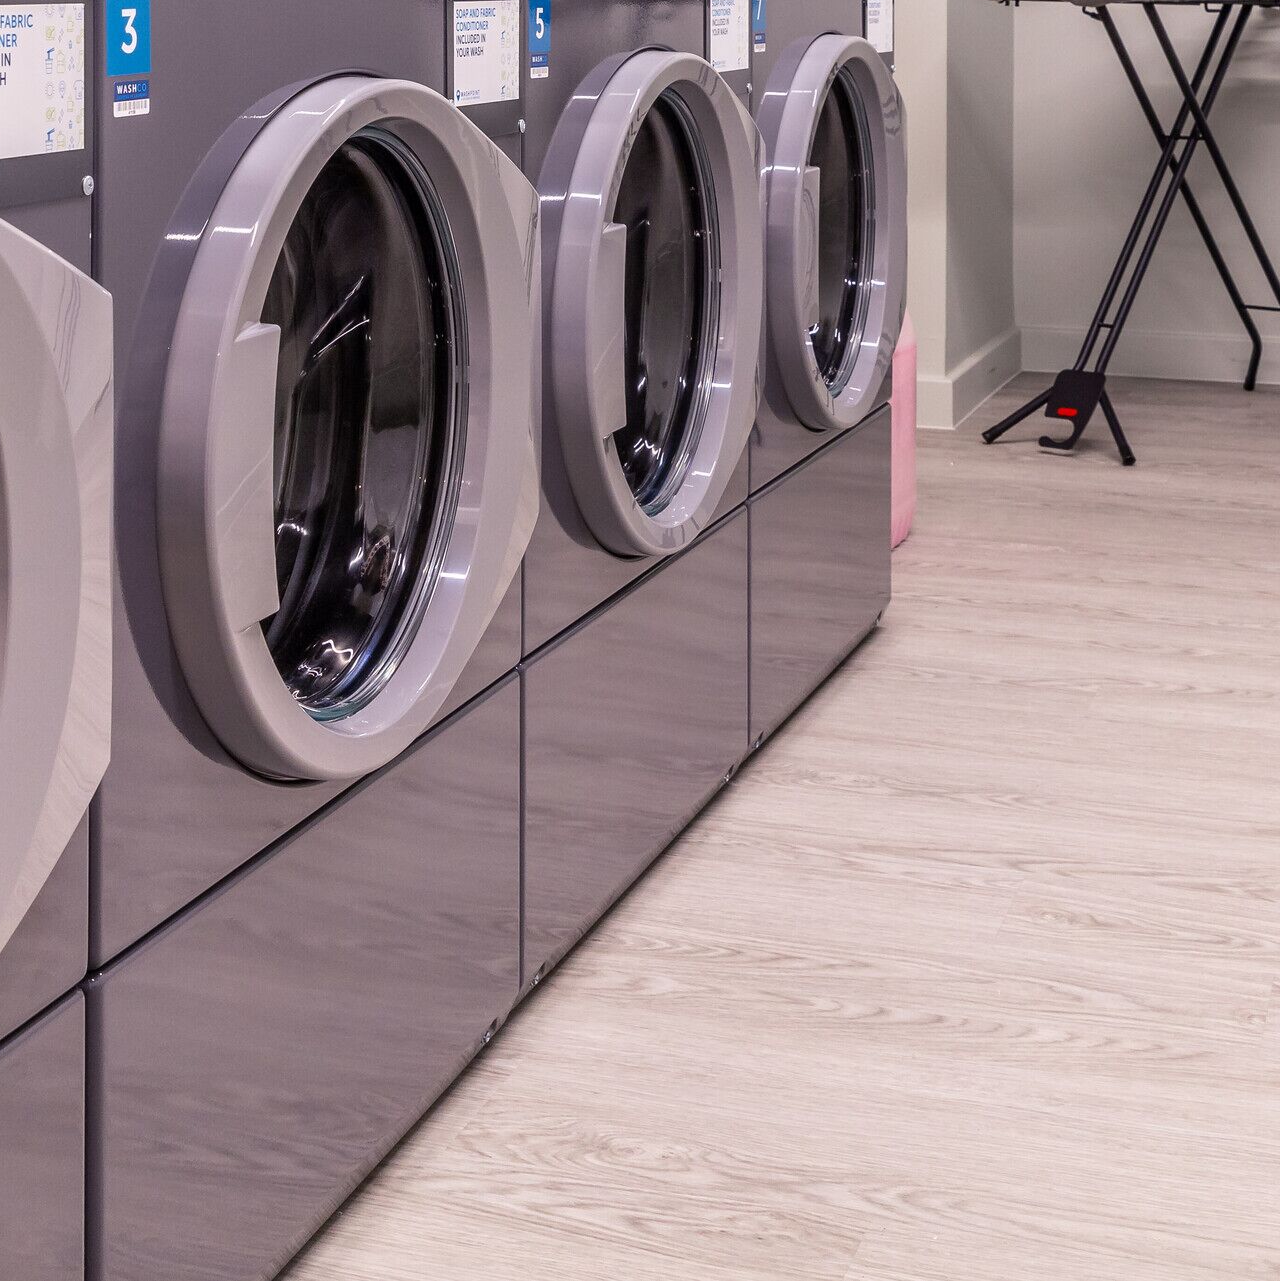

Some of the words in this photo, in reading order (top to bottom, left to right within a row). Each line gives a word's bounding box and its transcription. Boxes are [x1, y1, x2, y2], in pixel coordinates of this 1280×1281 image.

[712, 0, 720, 7] SOAP
[456, 8, 468, 19] SOAP
[469, 8, 479, 18] AND
[480, 7, 496, 18] FABRIC
[712, 8, 731, 16] CONDITIONER
[0, 14, 33, 29] FABRIC
[456, 21, 489, 32] CONDITIONER
[535, 7, 545, 39] 5
[120, 8, 137, 54] 3
[712, 28, 721, 36] YOUR
[456, 33, 480, 45] INCLUDED
[481, 33, 486, 43] IN
[456, 47, 470, 58] YOUR
[470, 46, 484, 57] WASH
[1, 53, 11, 67] IN
[116, 83, 147, 94] WASHCO
